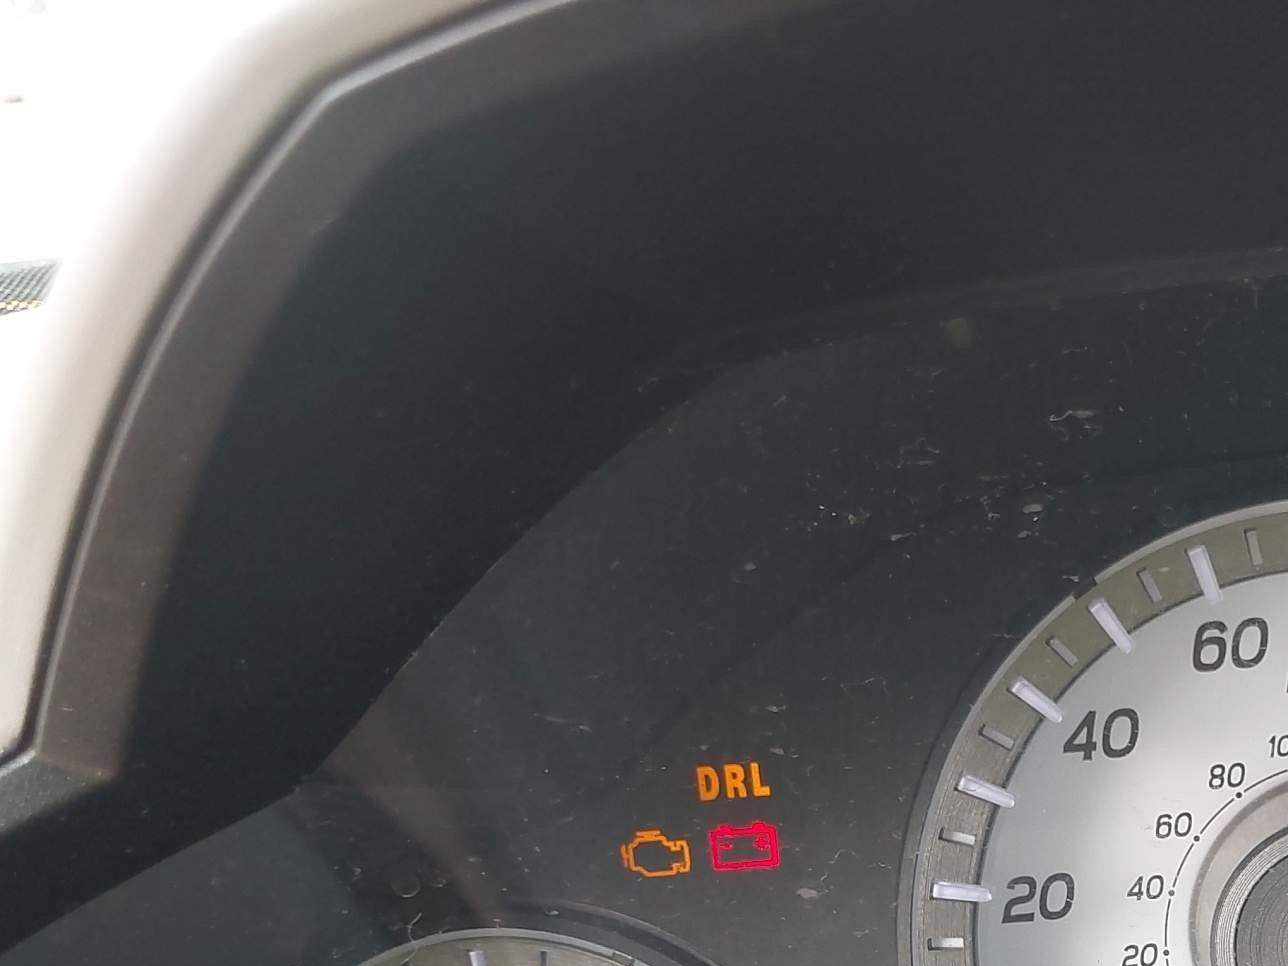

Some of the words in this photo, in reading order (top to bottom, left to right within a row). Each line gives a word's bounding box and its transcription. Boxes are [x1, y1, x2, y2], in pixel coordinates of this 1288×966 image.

[1190, 616, 1269, 673] 60
[1062, 706, 1140, 761] 40
[696, 762, 771, 801] DRL
[1209, 763, 1246, 790] 80
[1155, 813, 1193, 839] 60
[1001, 872, 1075, 924] 20
[1127, 875, 1165, 901] 40
